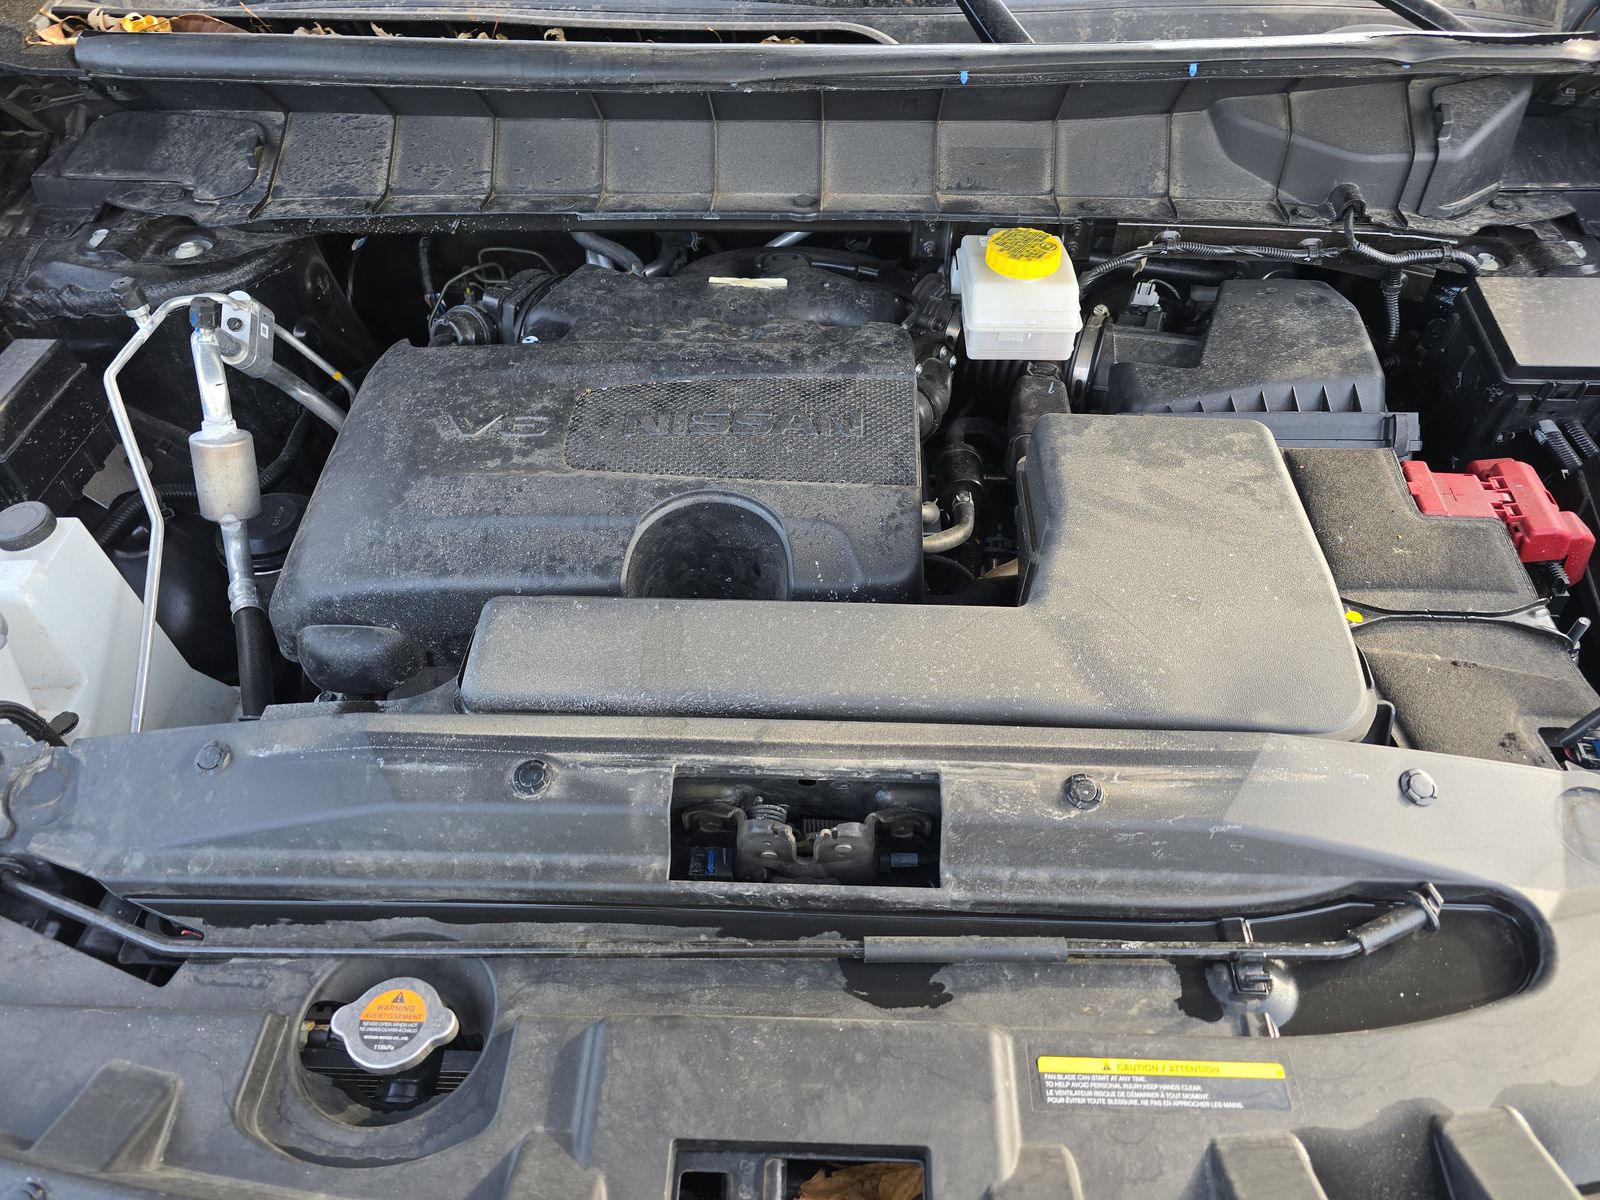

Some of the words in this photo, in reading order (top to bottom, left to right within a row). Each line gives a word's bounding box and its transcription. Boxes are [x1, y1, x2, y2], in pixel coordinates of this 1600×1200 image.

[623, 409, 865, 437] NISSAN
[377, 1004, 416, 1013] WARNING
[364, 1013, 423, 1021] AVERTISSEMENT
[1116, 1063, 1159, 1073] CAUTION
[1169, 1065, 1220, 1074] ATTENTION
